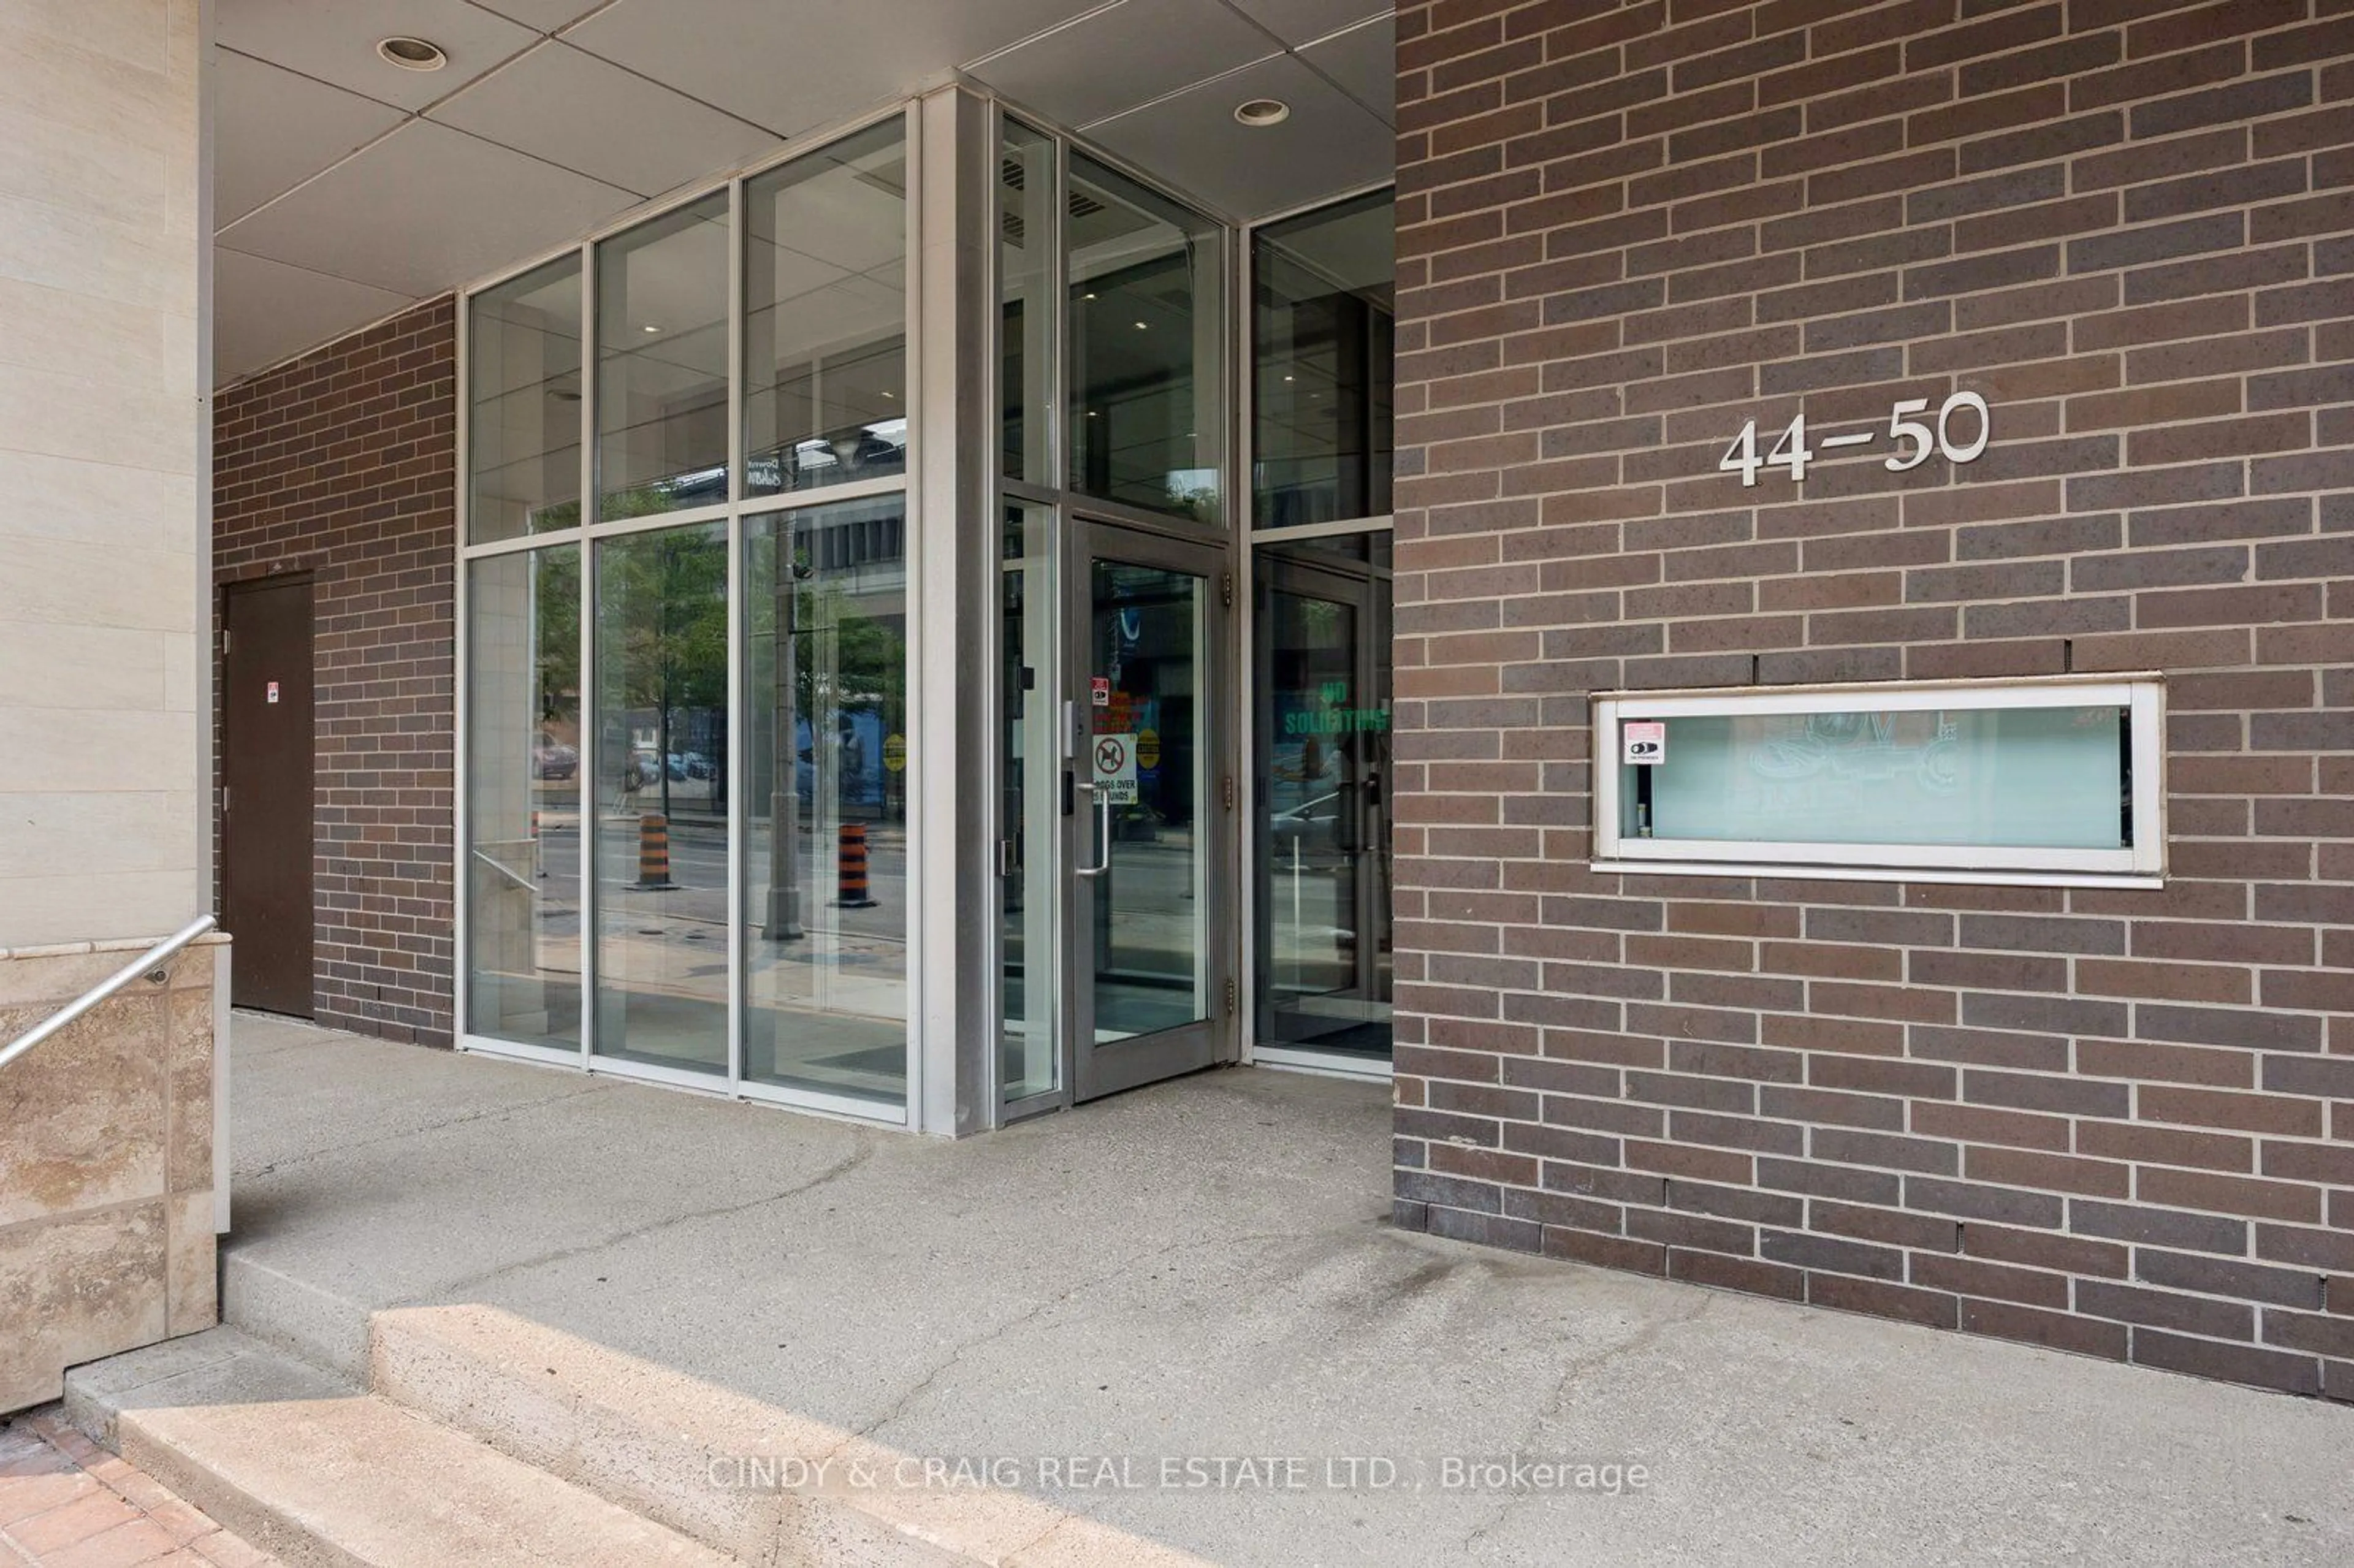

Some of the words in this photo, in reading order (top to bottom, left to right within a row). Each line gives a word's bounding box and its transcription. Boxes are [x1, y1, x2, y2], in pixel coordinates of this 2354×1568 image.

[1719, 390, 1990, 487] 44-50
[1321, 682, 1347, 703] NO
[1116, 779, 1135, 790] OVER
